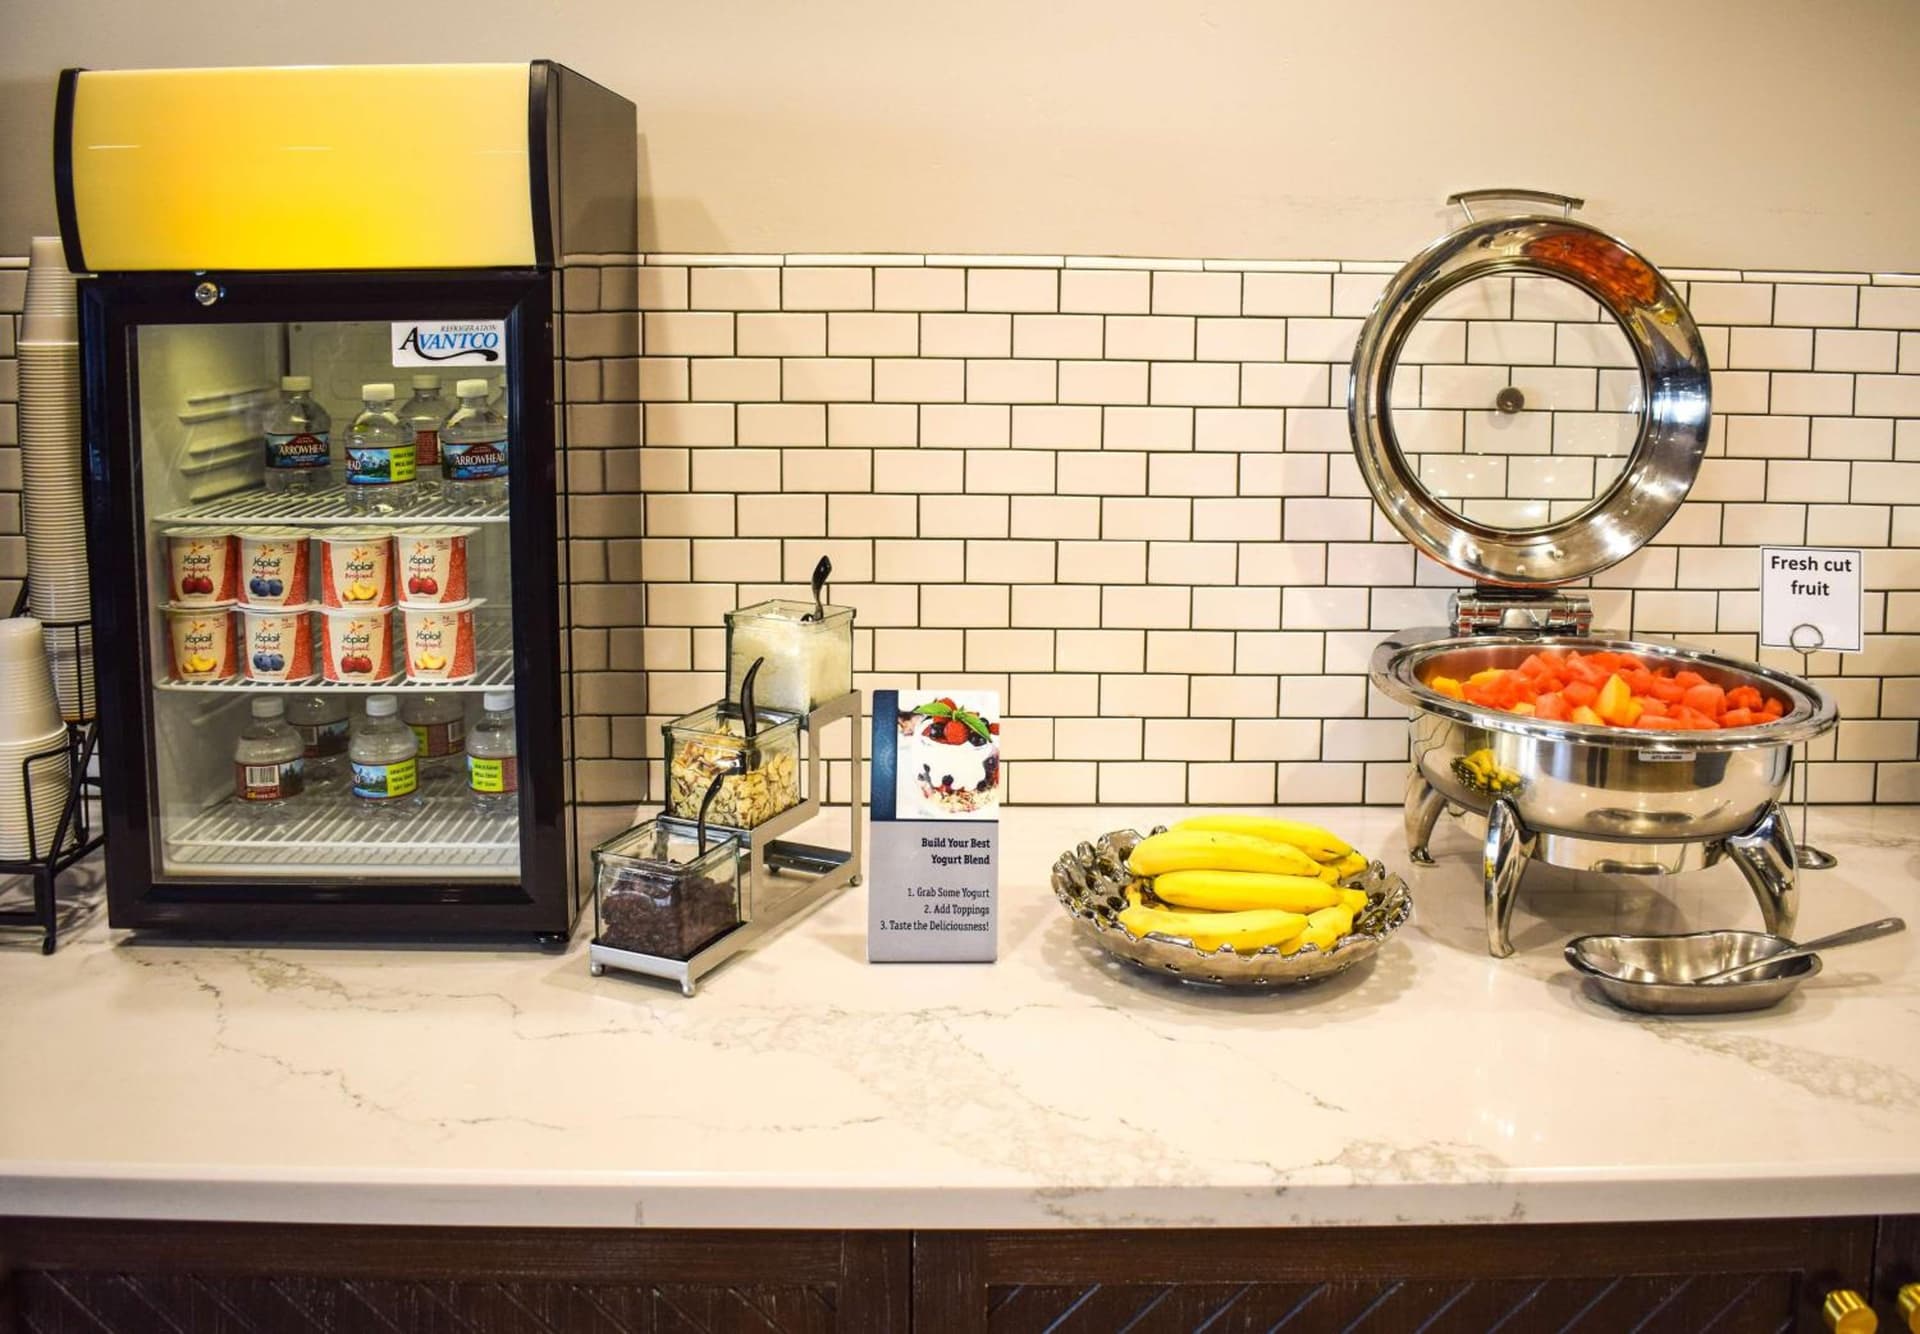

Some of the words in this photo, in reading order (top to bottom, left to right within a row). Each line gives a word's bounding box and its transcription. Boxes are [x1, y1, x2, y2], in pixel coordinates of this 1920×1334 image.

[398, 326, 499, 361] AVANTCO
[455, 453, 505, 466] ARROWHEAD
[184, 554, 211, 567] Yoplait
[252, 557, 281, 569] Yoplait
[409, 554, 436, 568] Yoplait
[1771, 555, 1819, 571] Fresh
[1824, 559, 1852, 572] cut
[345, 561, 375, 575] Yoplait
[1791, 580, 1830, 596] fruit
[184, 632, 213, 645] Yoplait
[254, 632, 281, 645] Yoplait
[343, 633, 370, 647] Yoplait
[416, 631, 442, 644] Yoplait
[921, 838, 946, 848] Build
[947, 838, 969, 848] Your
[970, 838, 991, 848] Best
[931, 854, 962, 866] Yogurt
[963, 855, 991, 865] Blend
[907, 888, 915, 897] 1.
[917, 887, 937, 897] Grab
[937, 888, 960, 897] Some
[961, 888, 990, 900] Yogurt
[924, 904, 932, 914] 2.
[934, 904, 951, 914] Add
[952, 904, 990, 917] Toppings
[880, 921, 888, 930] 3.
[889, 920, 912, 930] Taste
[913, 920, 928, 930] the
[929, 920, 989, 931] Deliciousness!
